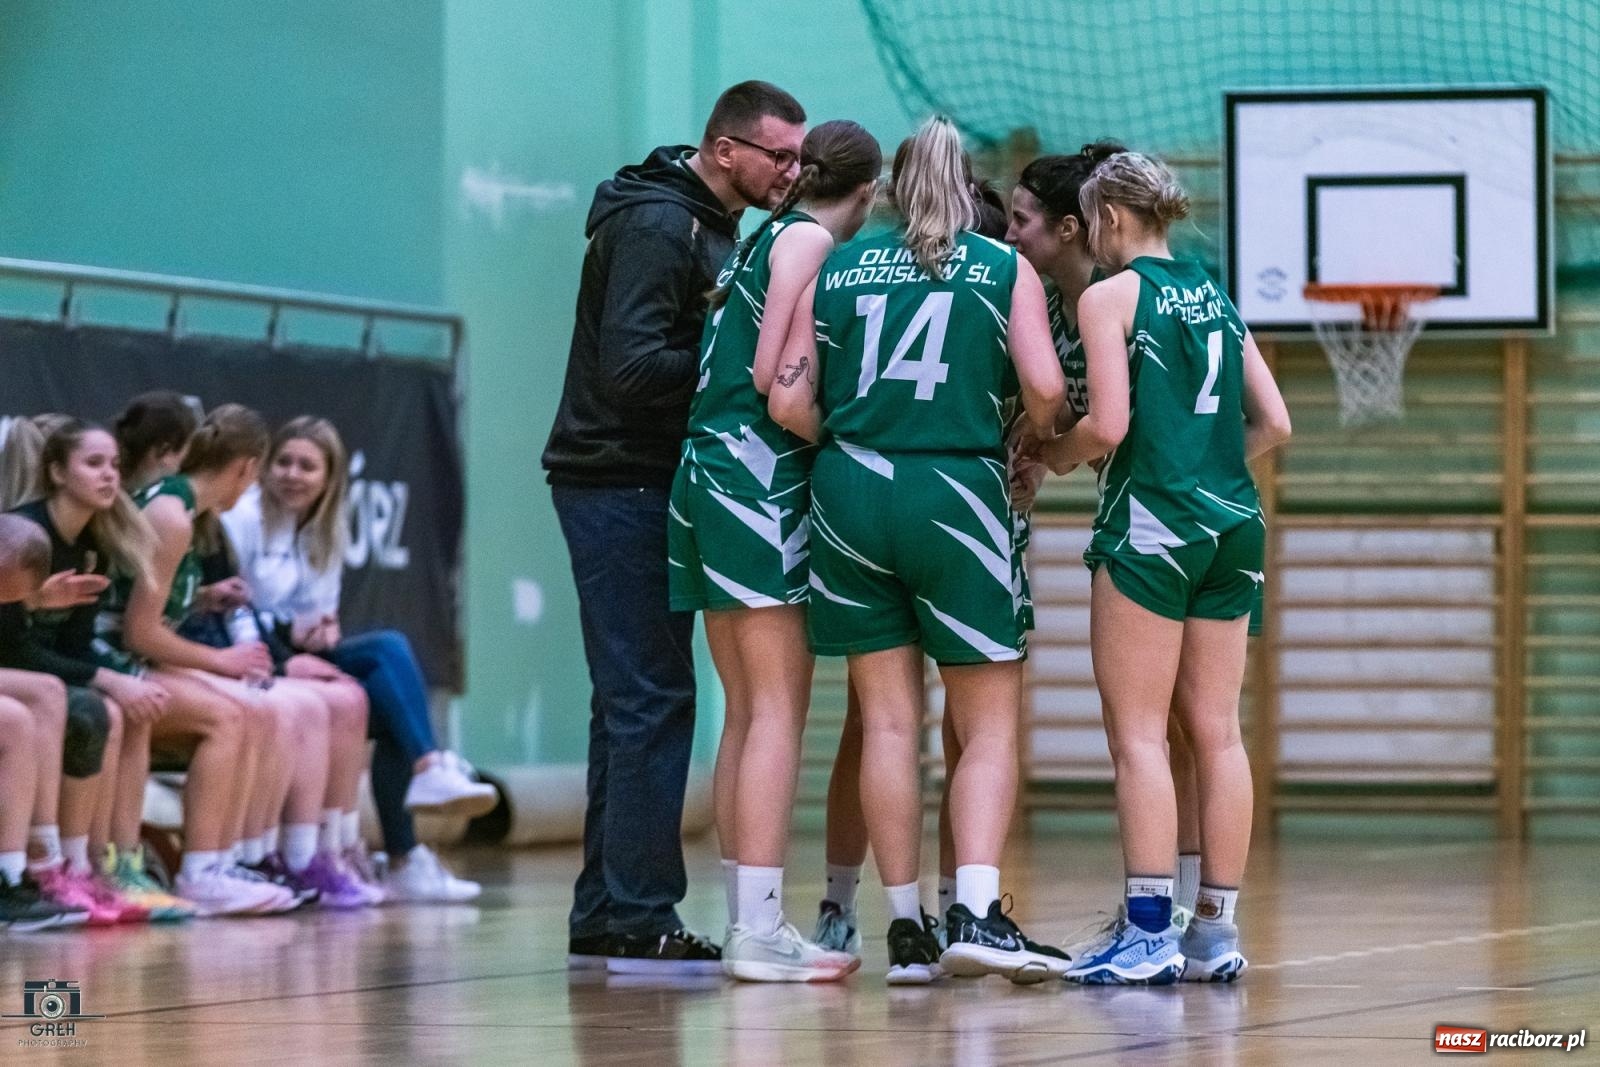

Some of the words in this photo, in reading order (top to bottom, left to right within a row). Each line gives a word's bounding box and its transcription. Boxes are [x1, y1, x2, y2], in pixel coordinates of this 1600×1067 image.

[858, 244, 968, 266] OLIMA
[965, 262, 997, 286] ŚL.
[855, 291, 955, 401] 14
